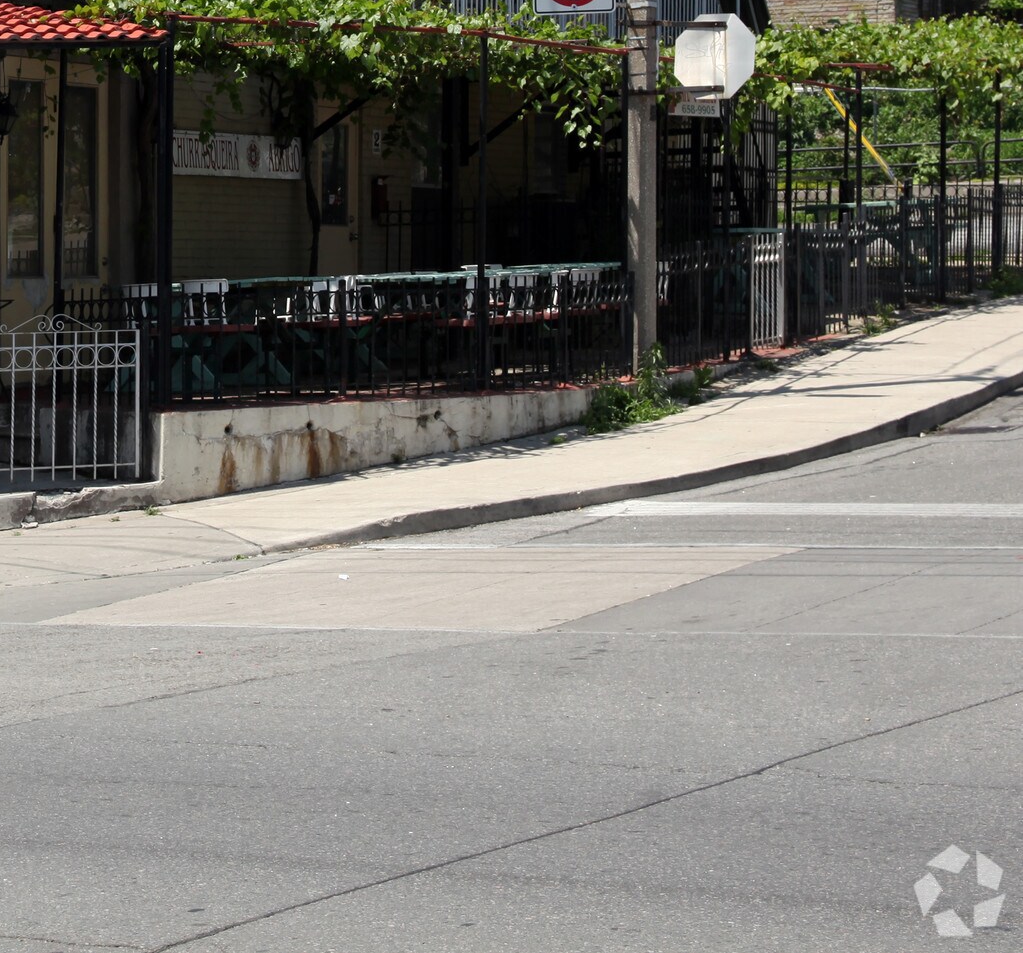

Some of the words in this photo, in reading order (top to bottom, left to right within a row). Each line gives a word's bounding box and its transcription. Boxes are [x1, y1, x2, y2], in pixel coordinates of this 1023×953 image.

[681, 104, 716, 115] 658-9905
[374, 132, 380, 147] 2
[268, 143, 301, 173] ABRIGO
